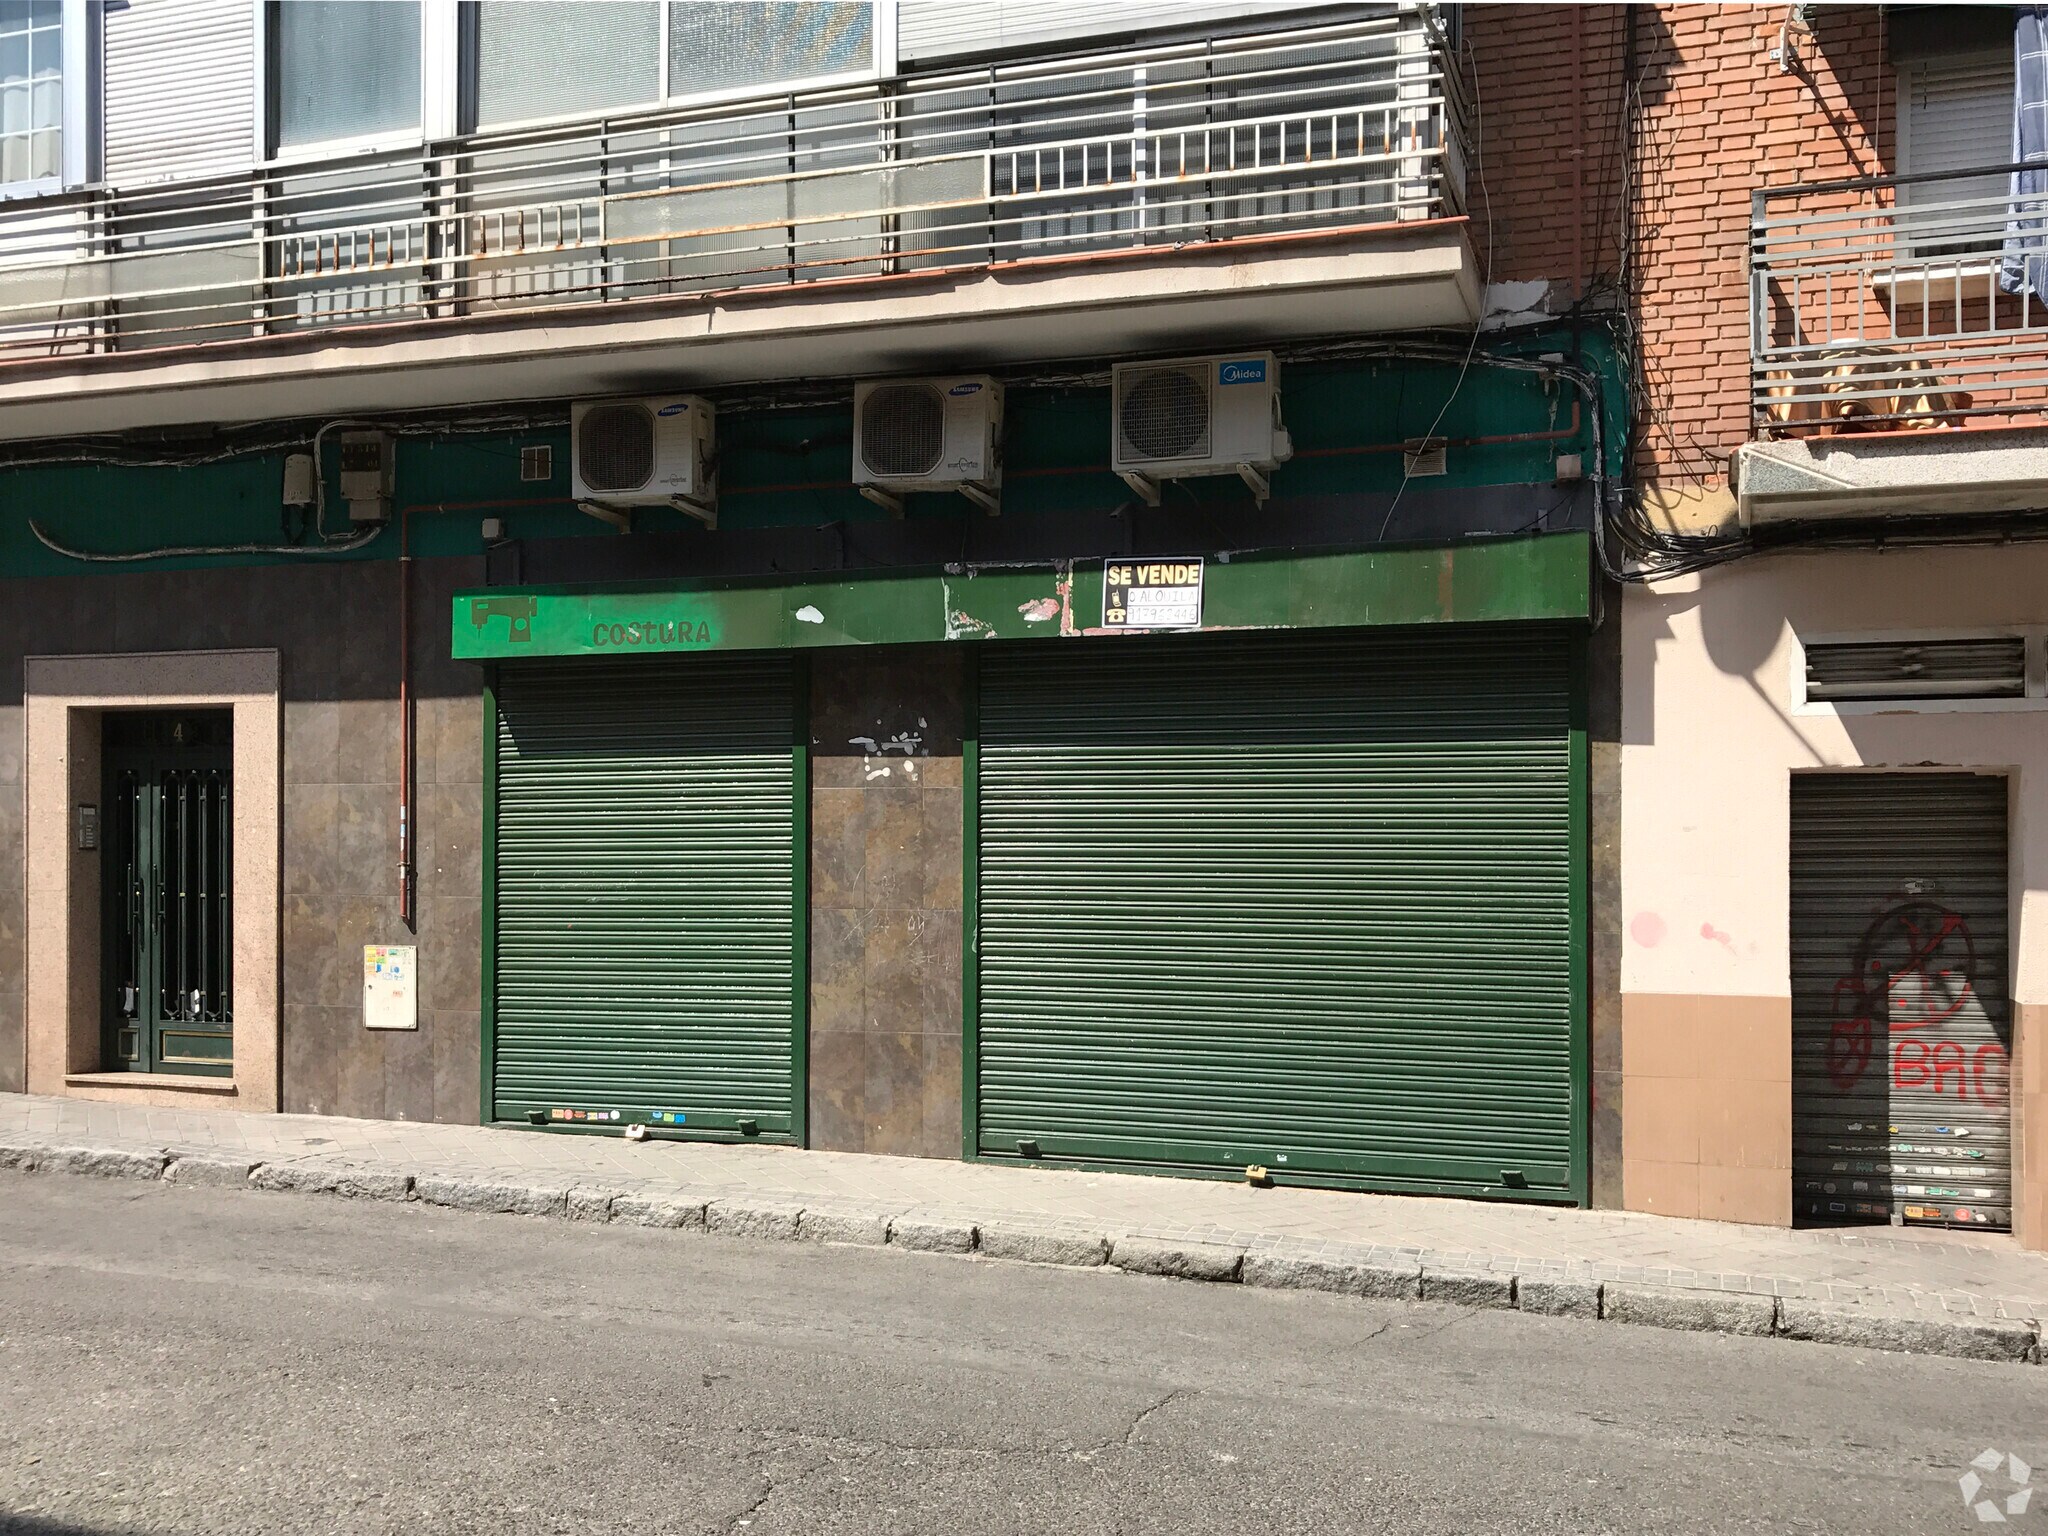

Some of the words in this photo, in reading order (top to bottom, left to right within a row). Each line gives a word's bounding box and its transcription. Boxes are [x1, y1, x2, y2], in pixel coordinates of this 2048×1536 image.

[1223, 366, 1262, 382] Midea
[1108, 565, 1132, 585] SE
[1136, 564, 1200, 585] VENDE
[173, 722, 183, 742] 4
